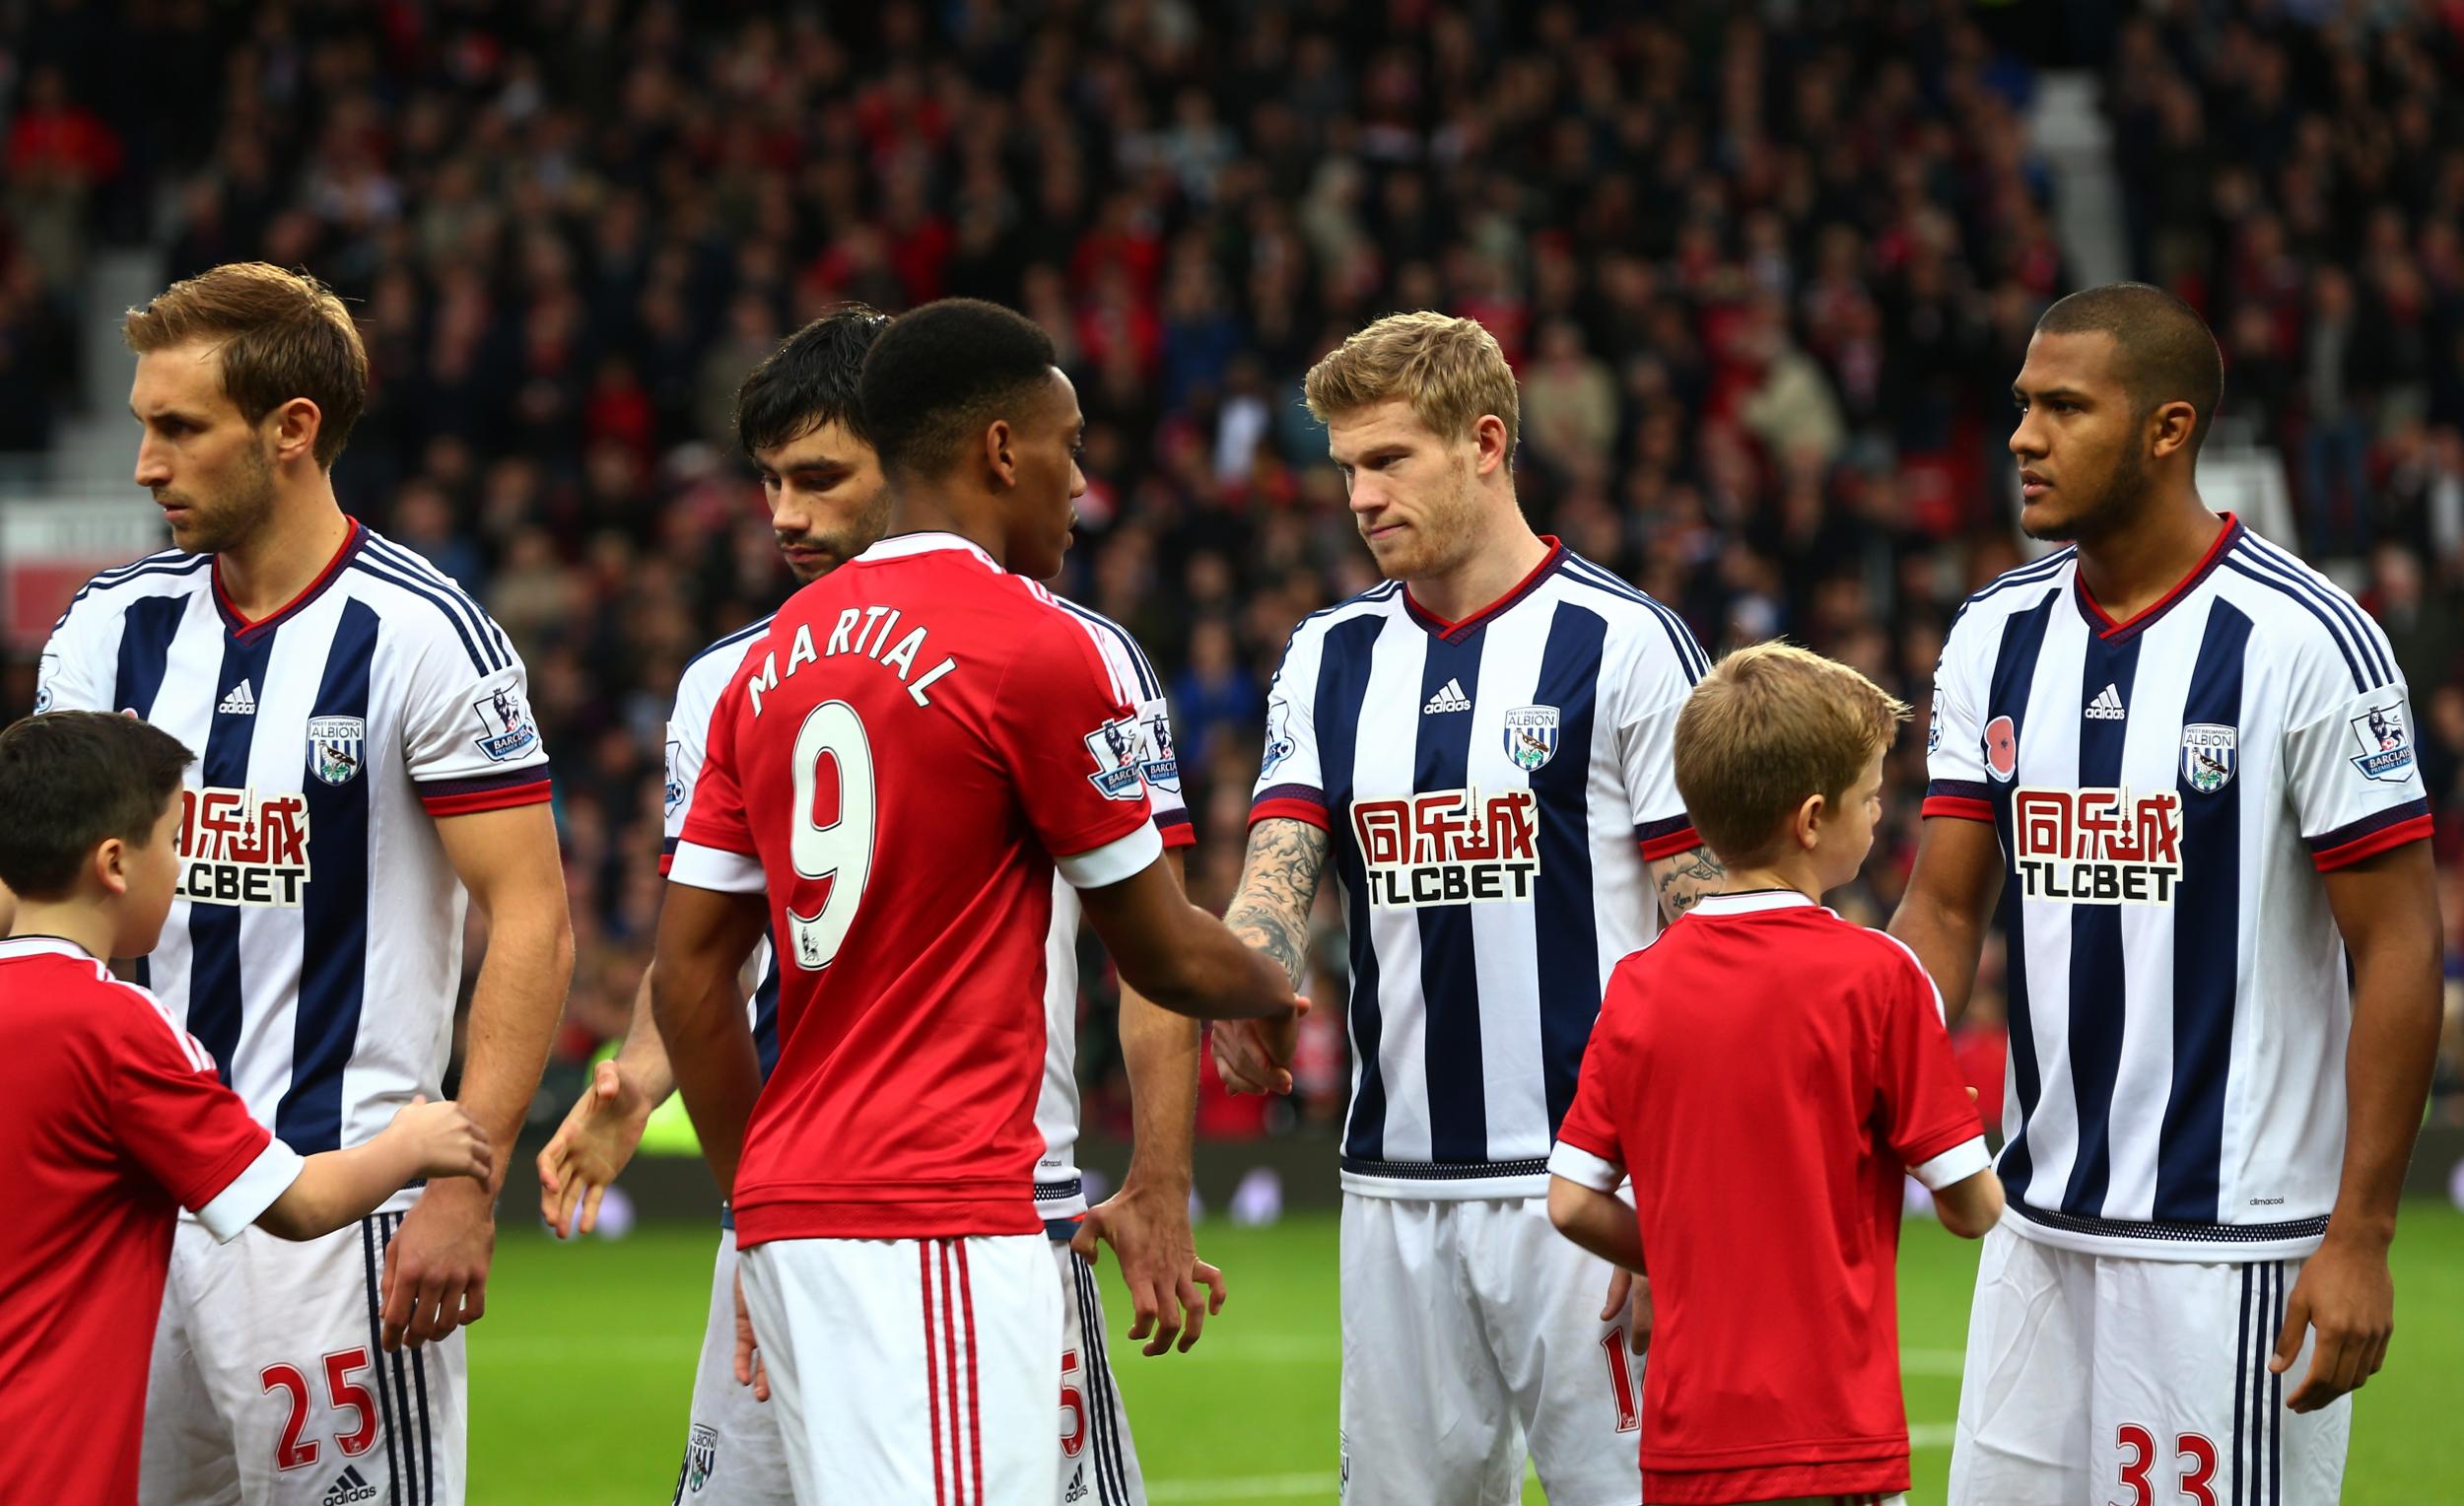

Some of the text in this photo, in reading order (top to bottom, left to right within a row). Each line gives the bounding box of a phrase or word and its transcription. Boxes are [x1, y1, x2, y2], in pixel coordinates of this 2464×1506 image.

[748, 605, 958, 718] MARTIAL
[219, 701, 256, 716] adidas
[1423, 699, 1472, 716] adidas
[1508, 715, 1555, 726] ALBION
[2085, 706, 2125, 719] adidas
[310, 726, 361, 738] ALBION
[2185, 733, 2232, 746] ALBION
[787, 699, 876, 971] 9
[175, 862, 306, 904] CBET
[1368, 862, 1535, 906] TLCBET
[2019, 860, 2178, 902] TLCBET
[1600, 1325, 1644, 1434] 1
[259, 1344, 379, 1472] 25
[2108, 1422, 2220, 1506] 33
[323, 1485, 376, 1506] adidas
